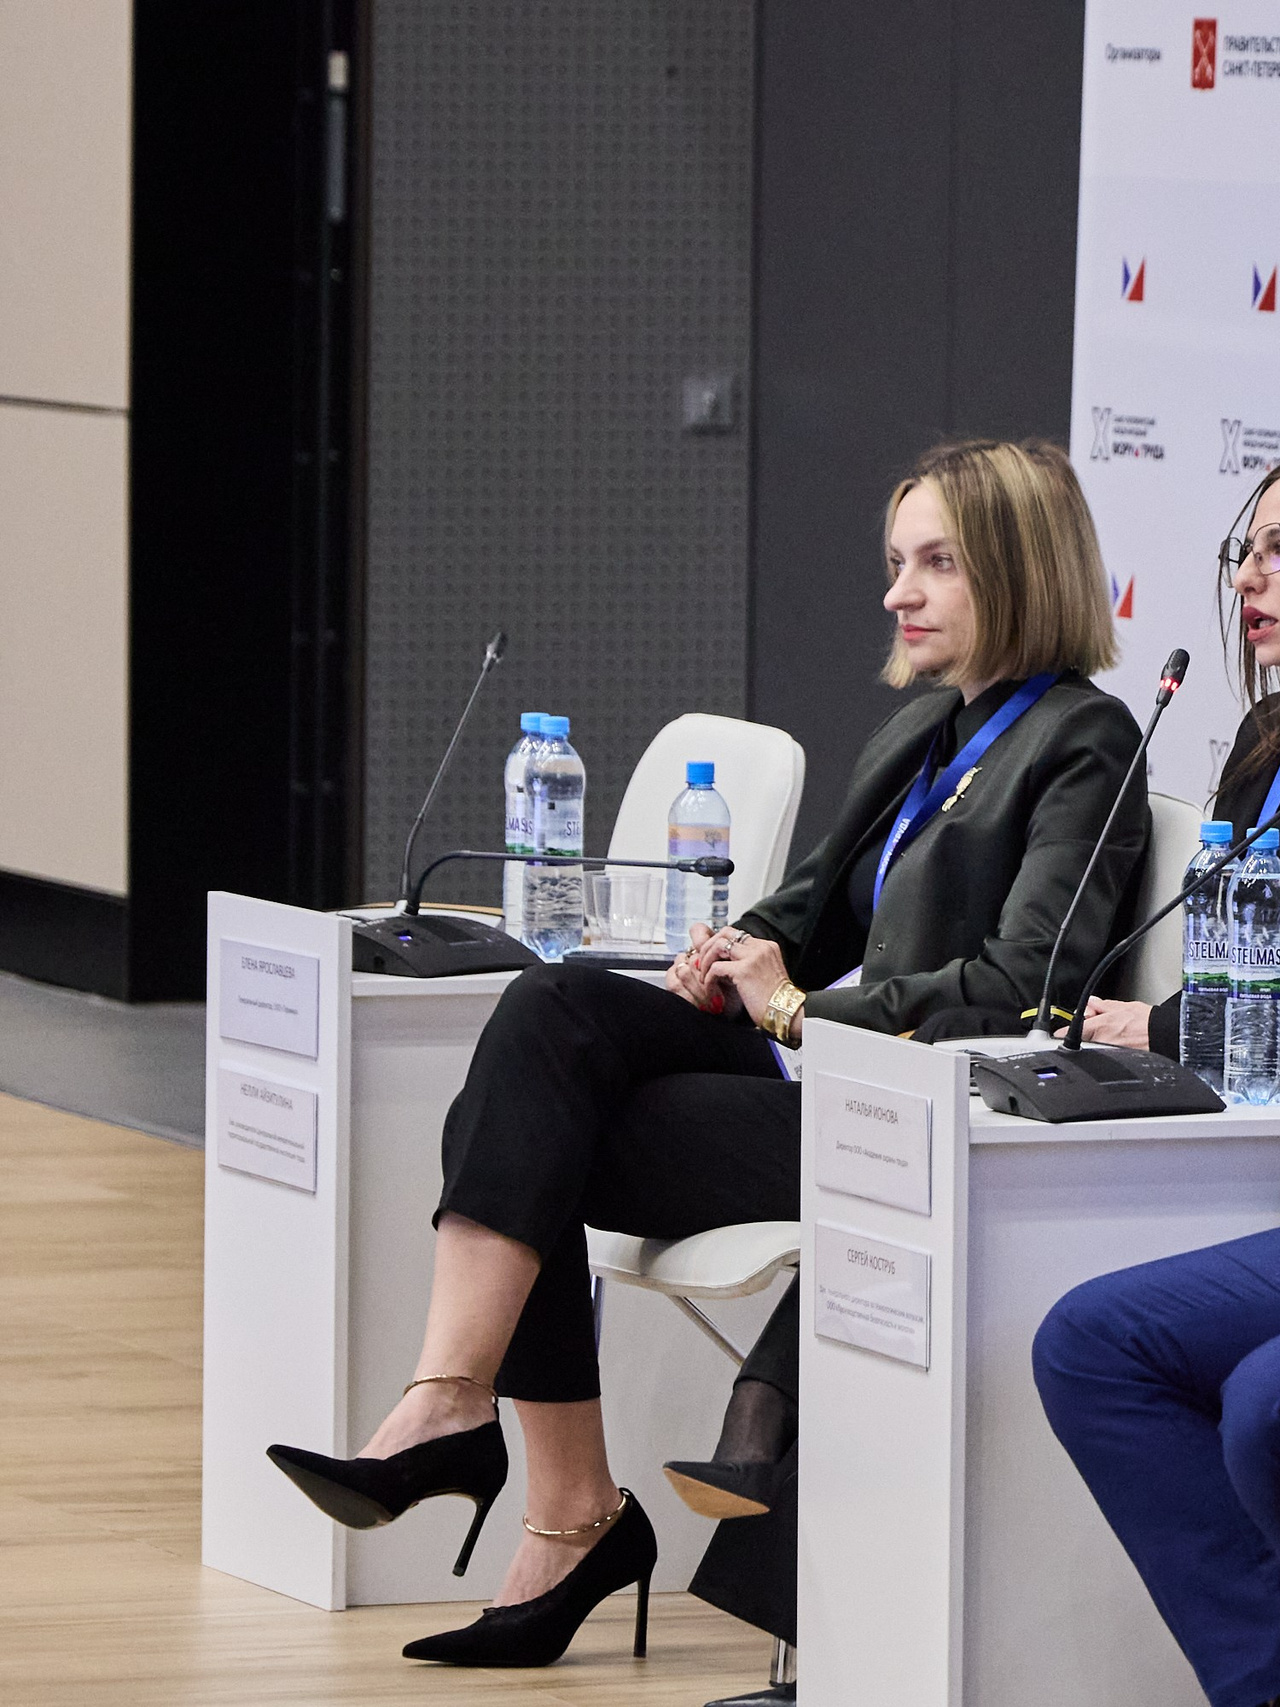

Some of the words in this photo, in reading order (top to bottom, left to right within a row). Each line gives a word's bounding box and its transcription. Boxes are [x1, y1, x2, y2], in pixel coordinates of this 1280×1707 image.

[1189, 941, 1228, 959] STELM
[845, 1099, 873, 1117] НАТАЛЬЯ
[873, 1106, 898, 1124] ИОНОВА
[847, 1248, 868, 1267] СЕРГЕЙ
[869, 1256, 895, 1275] КОСТРУБ
